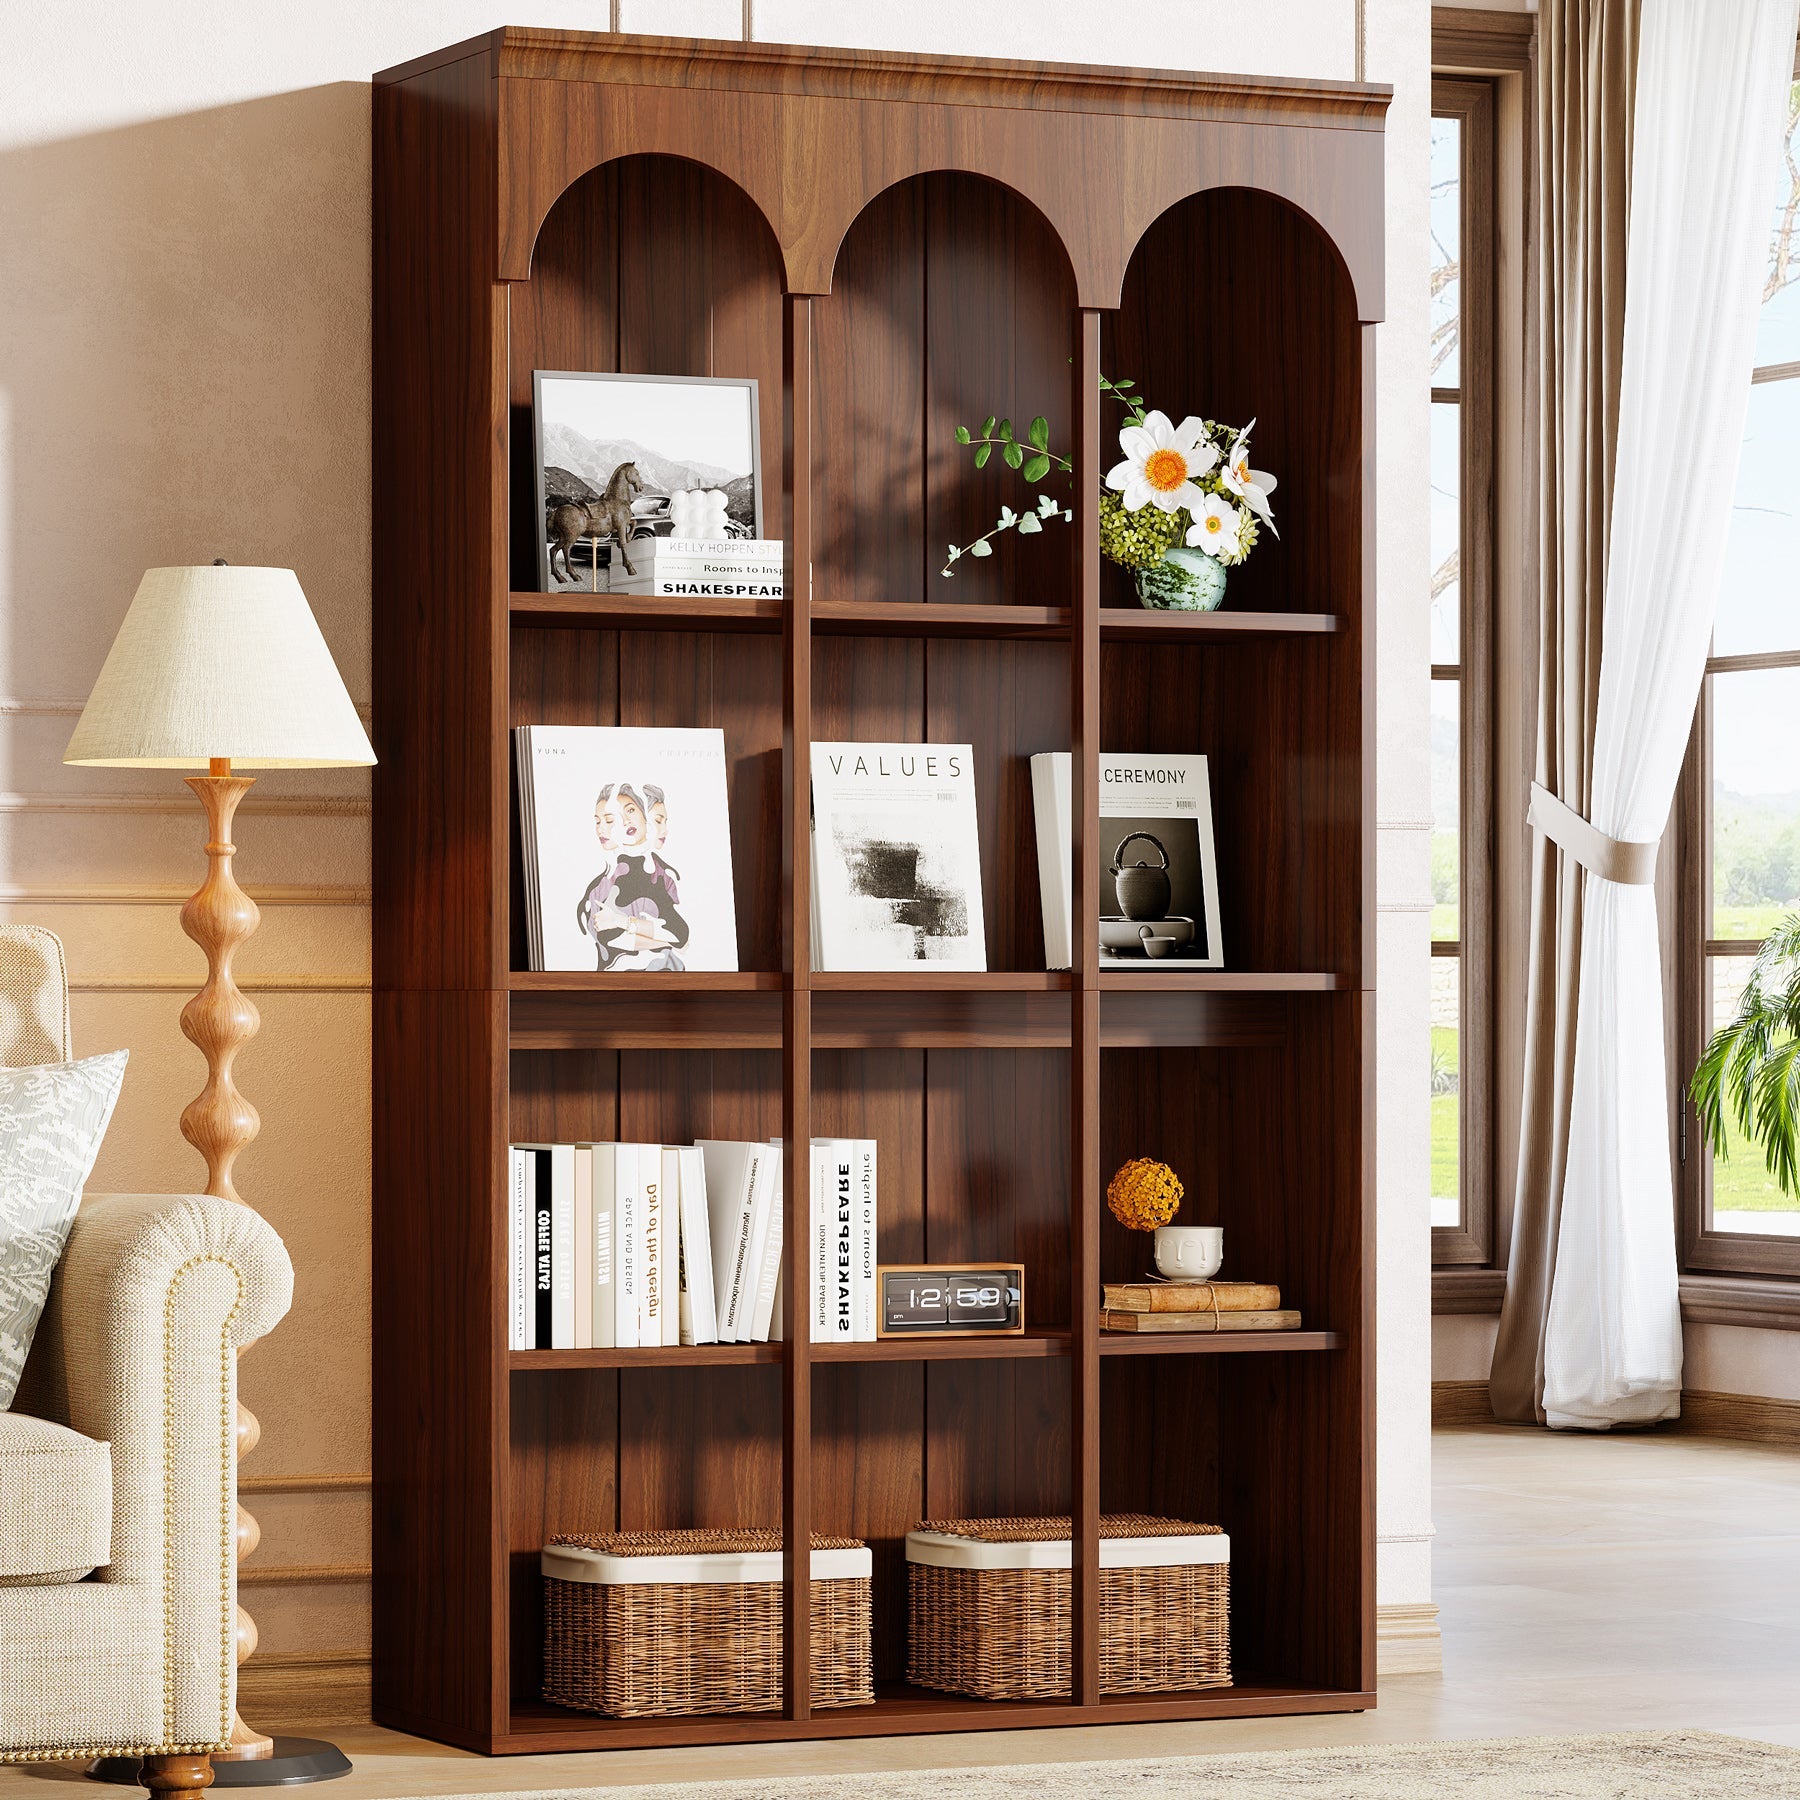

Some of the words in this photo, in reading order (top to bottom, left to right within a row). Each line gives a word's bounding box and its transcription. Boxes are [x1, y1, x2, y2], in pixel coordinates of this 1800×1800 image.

[669, 542, 705, 553] KELLY
[708, 543, 754, 554] HOPPEN
[704, 564, 743, 573] Rooms
[746, 565, 759, 574] to
[663, 583, 782, 596] SHAKESPEAR
[537, 747, 566, 755] YUNA
[829, 755, 961, 777] VALUES
[1104, 768, 1186, 784] CEREMONY
[909, 1288, 941, 1308] 12
[956, 1287, 1001, 1307] 59
